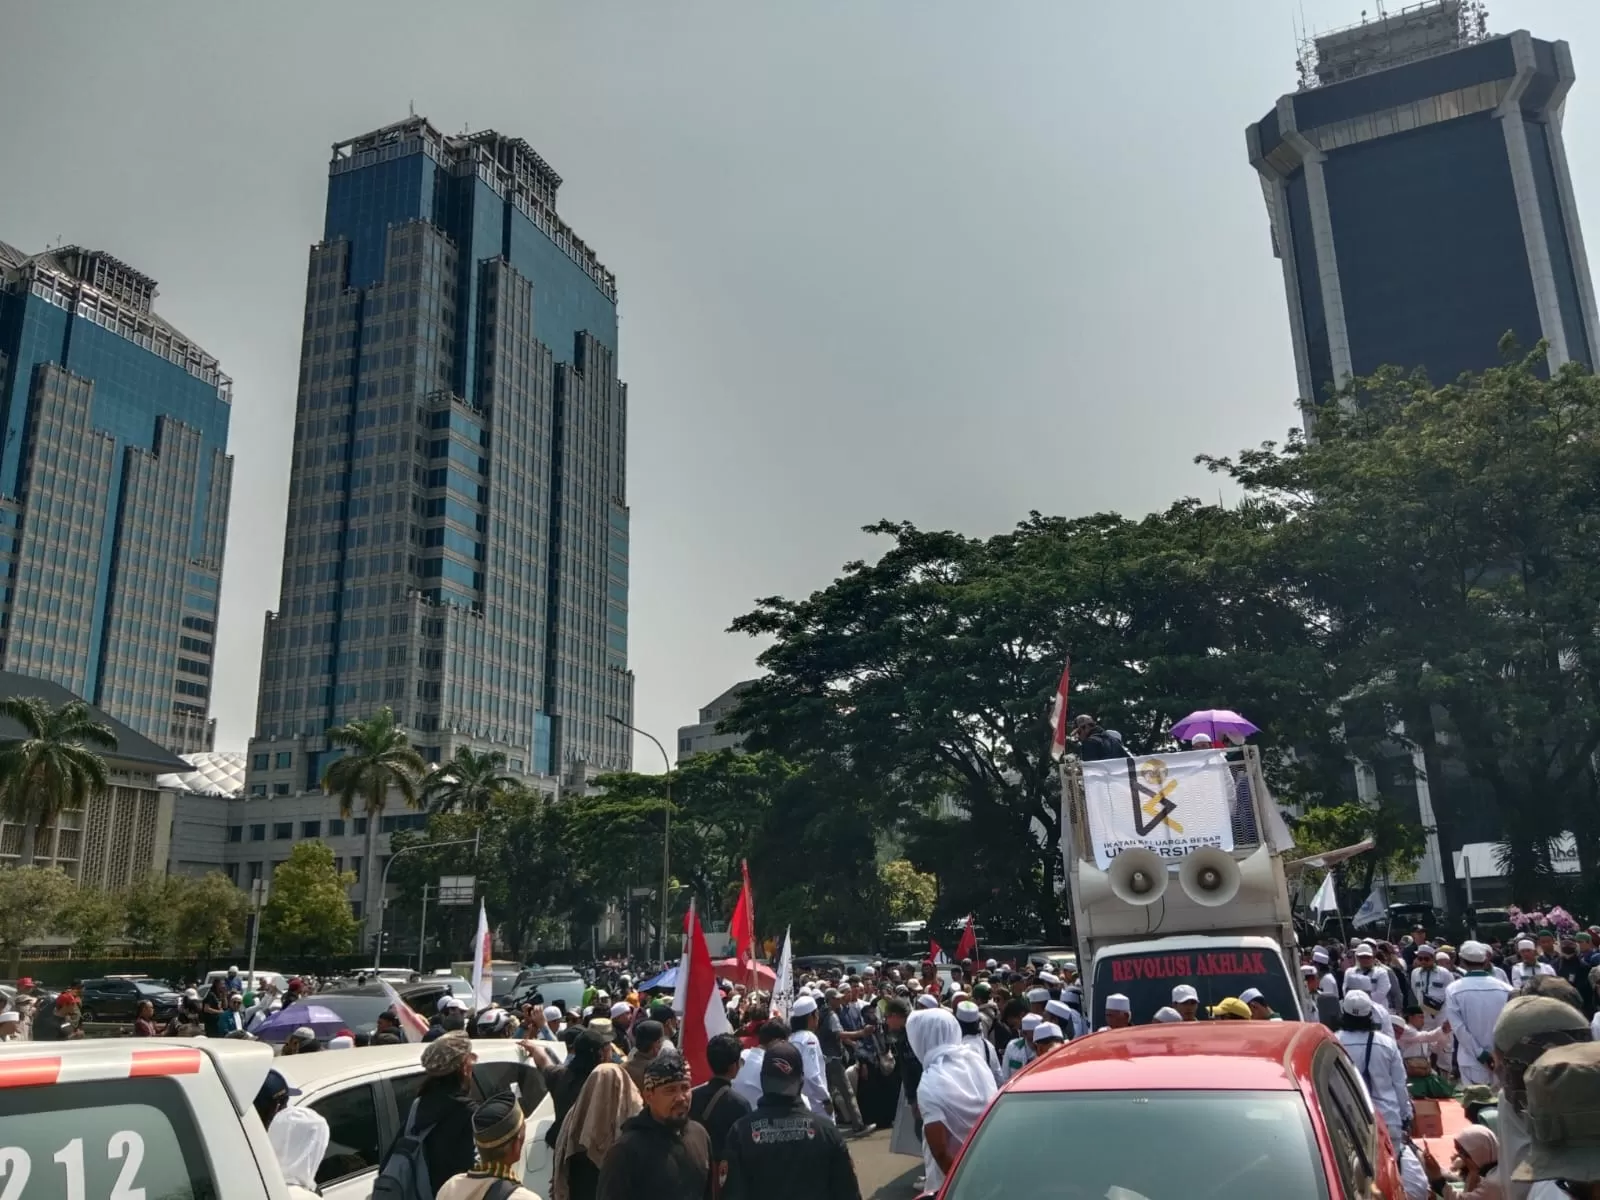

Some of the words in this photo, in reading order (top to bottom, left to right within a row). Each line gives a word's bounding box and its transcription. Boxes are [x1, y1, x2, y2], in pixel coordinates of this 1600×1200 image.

[1104, 840, 1137, 848] IKATAN
[1138, 838, 1188, 846] KELUARGA
[1190, 835, 1221, 844] BESAR
[1112, 955, 1192, 982] REVOLUSI
[1197, 952, 1266, 975] AKHLAK
